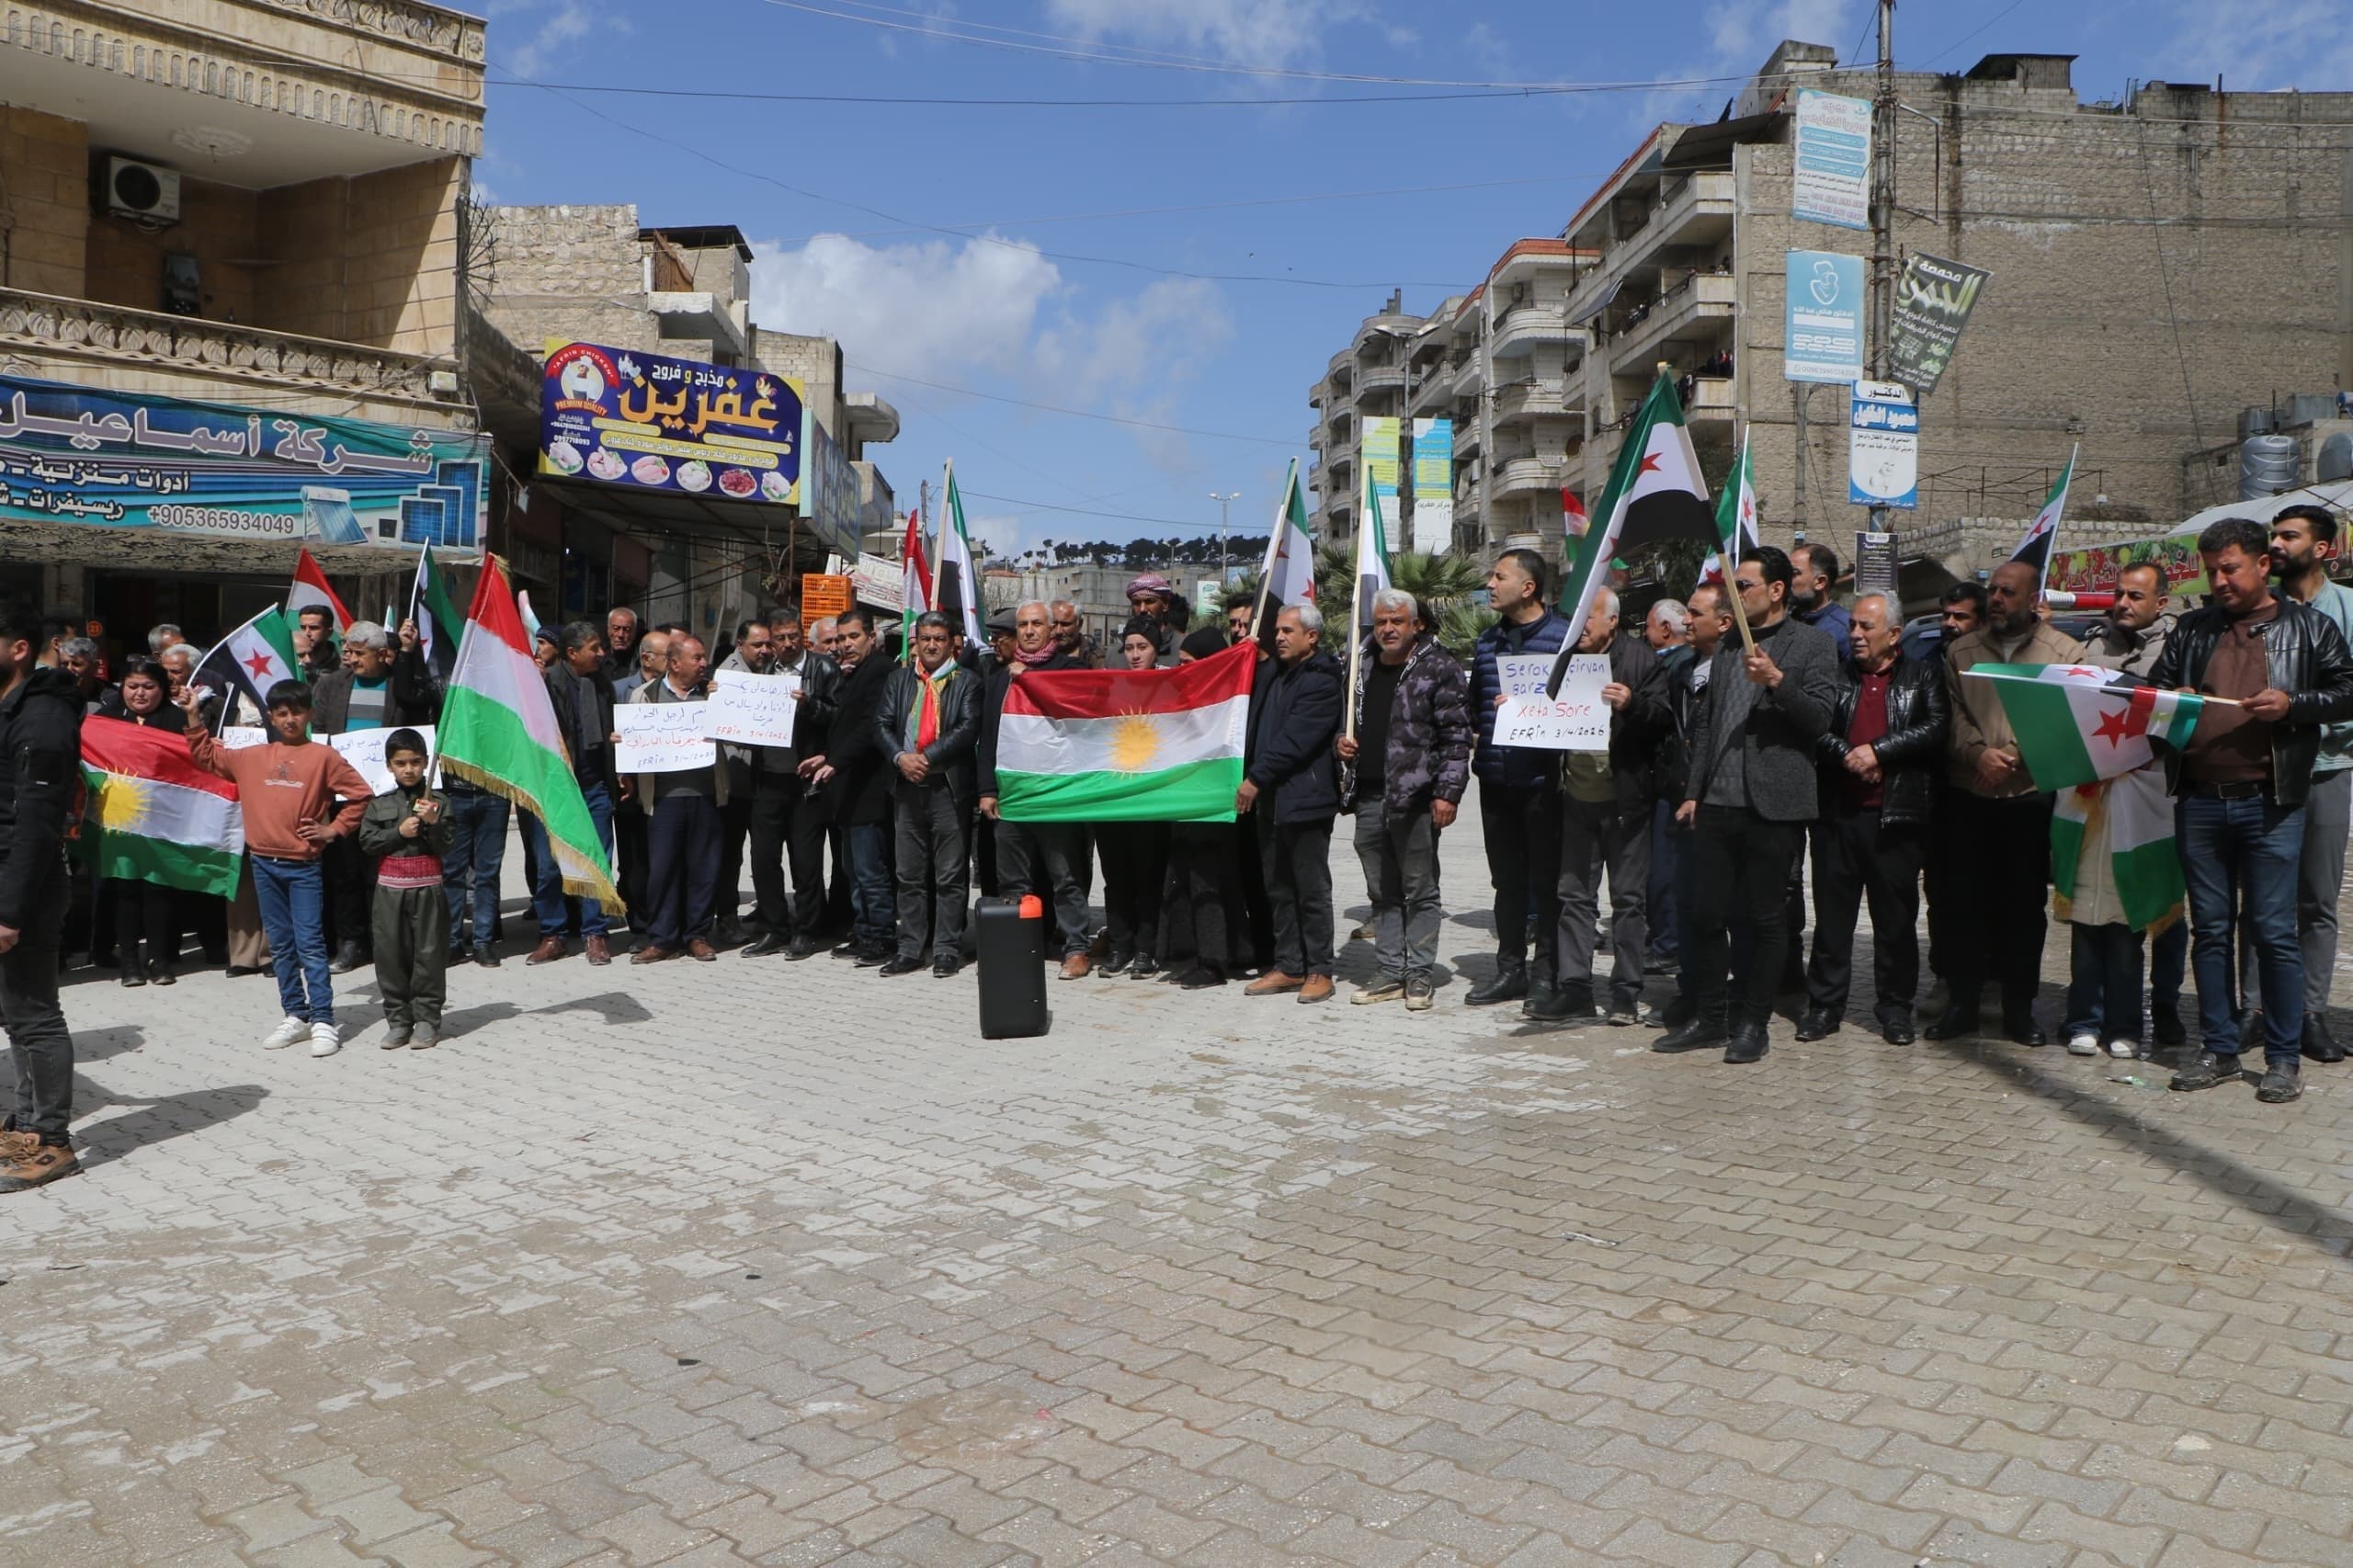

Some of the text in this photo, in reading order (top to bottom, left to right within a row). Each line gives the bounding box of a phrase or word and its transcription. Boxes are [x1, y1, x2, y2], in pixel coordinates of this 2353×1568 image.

[1919, 260, 1962, 283] محمصة
[652, 364, 724, 387] مذبح و فروج
[618, 374, 780, 437] عفرين
[1868, 387, 1905, 399] الدكتور
[273, 418, 435, 475] شركة
[30, 454, 130, 487] منزلية
[135, 465, 191, 494] أدوات
[28, 487, 125, 521] ريسيفرات
[147, 505, 295, 535] +905365934049
[1506, 662, 1551, 678] Serok
[692, 705, 707, 724] نعم
